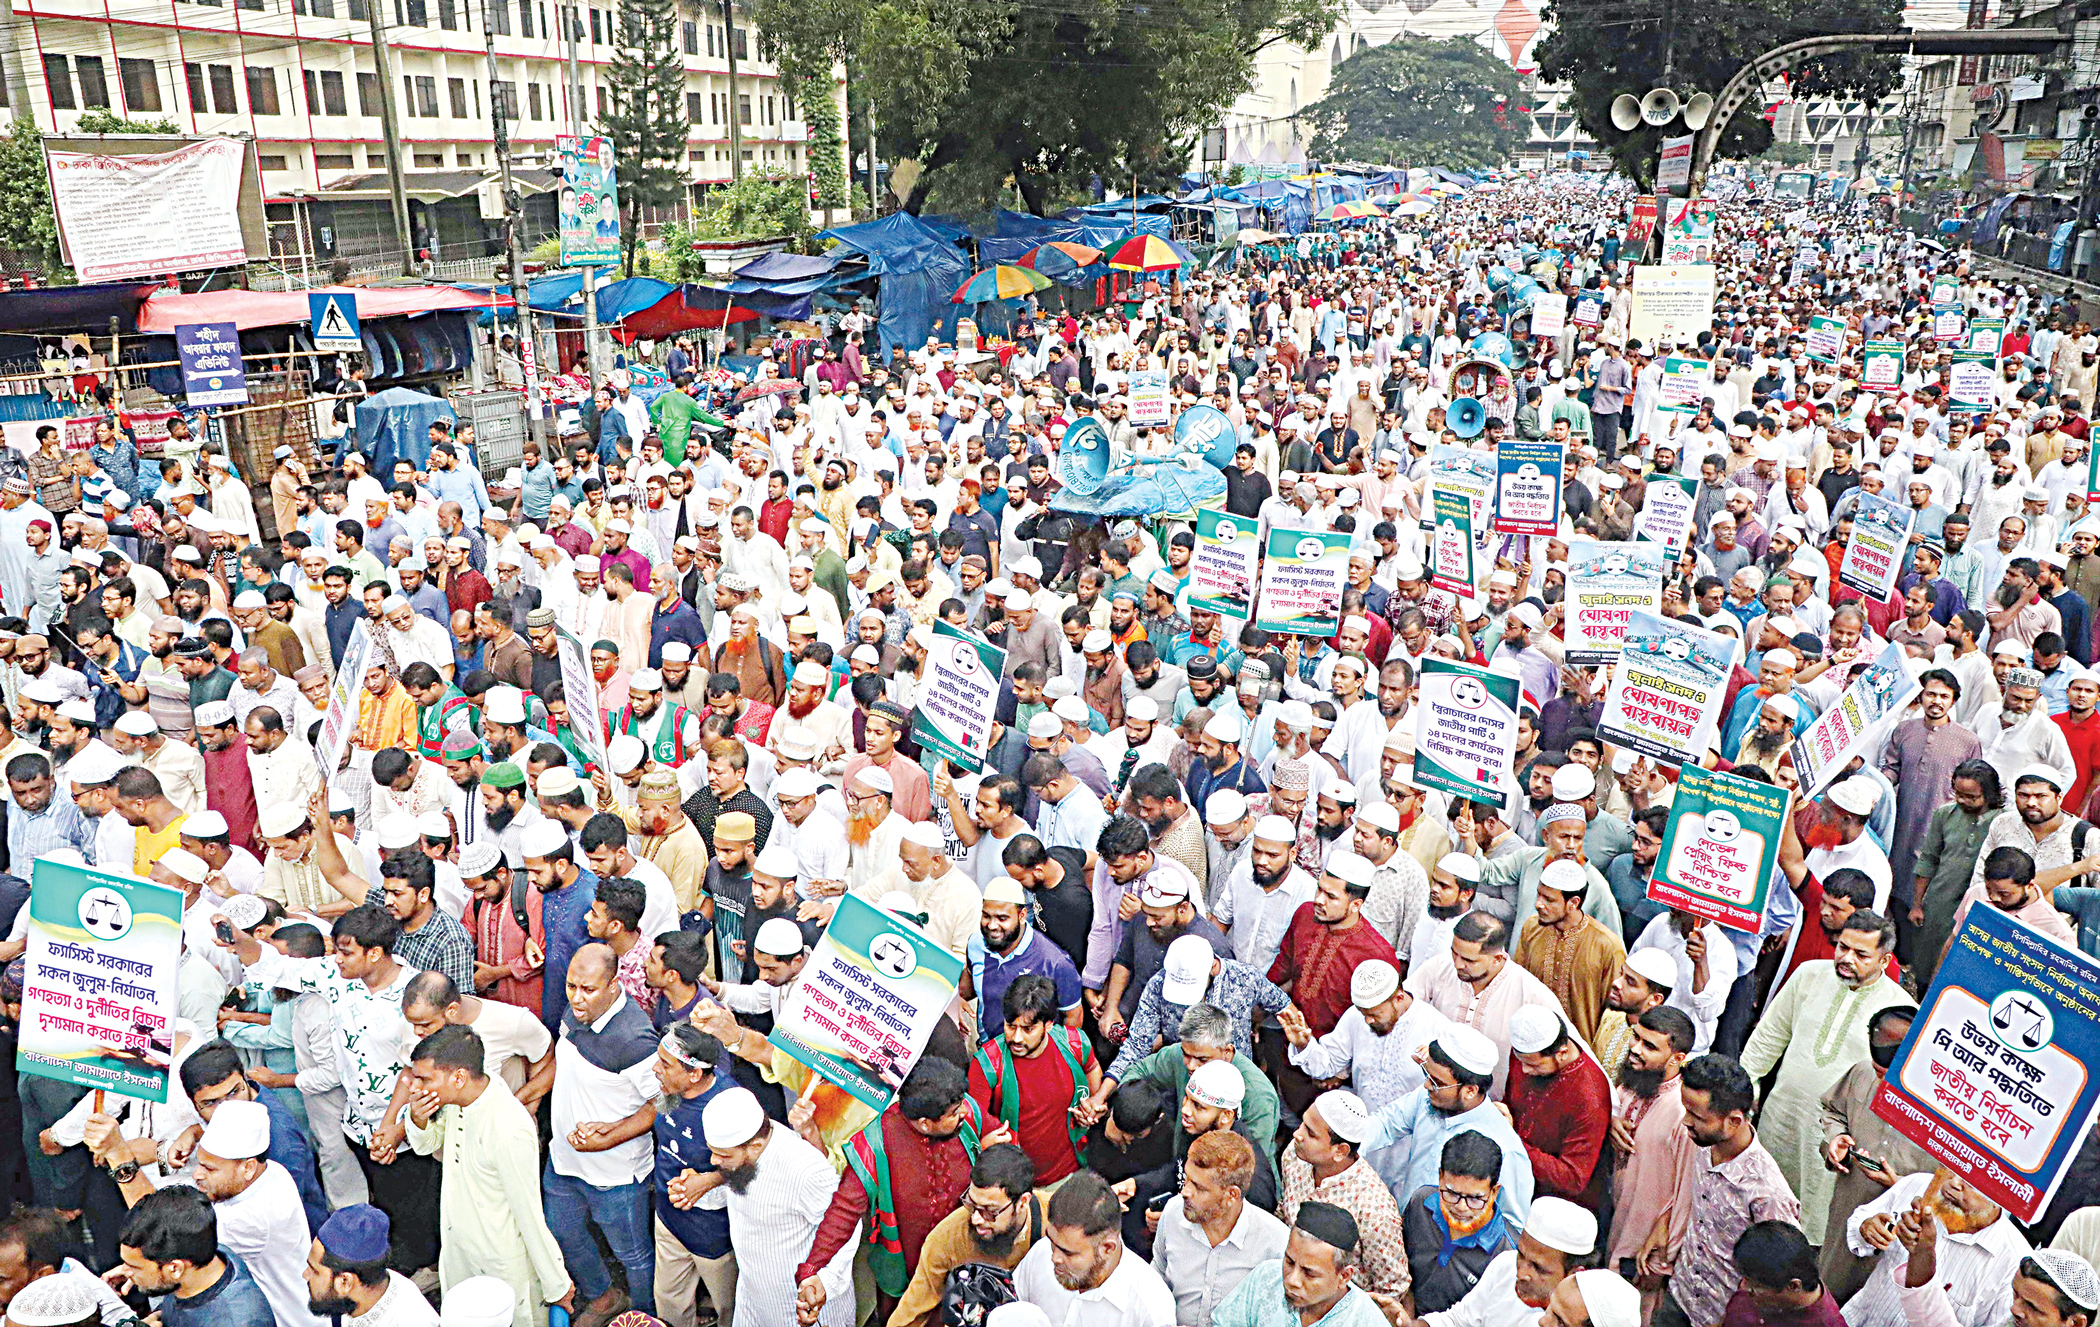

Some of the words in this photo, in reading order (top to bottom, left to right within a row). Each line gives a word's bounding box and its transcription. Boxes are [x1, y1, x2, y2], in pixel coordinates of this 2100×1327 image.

[182, 343, 211, 356] আবরার
[211, 341, 236, 353] ফাহাদ
[195, 327, 220, 341] শহীদ
[195, 355, 230, 369] এভিনিউ
[521, 342, 535, 376] UCC
[1851, 556, 1886, 579] বাস্তবায়ন
[1852, 544, 1892, 568] ঘোষণাপত্র
[1579, 609, 1633, 624] ঘোষণা
[1580, 593, 1615, 605] জুলাই
[1615, 594, 1641, 605] সনদ
[1643, 596, 1652, 606] ও
[935, 662, 969, 688] স্বৈরাচারের
[969, 680, 989, 698] দোসর
[937, 679, 959, 697] জাতীয়
[961, 690, 977, 705] পার্টি
[1627, 669, 1663, 691] জুলাই
[1664, 680, 1695, 699] সনদ
[1695, 692, 1706, 703] ও
[926, 698, 946, 718] নিষিদ্ধ
[948, 711, 968, 727] করতে
[928, 688, 939, 700] ১৪
[939, 695, 957, 710] দলের
[959, 702, 986, 724] কার্যক্রম
[1432, 701, 1477, 723] স্বৈরাচারের
[1478, 715, 1505, 730] দোসর
[1621, 701, 1695, 739] বাস্তবায়ন
[1622, 685, 1702, 724] ঘোষণাপত্র
[1428, 729, 1440, 739] ১৪
[1442, 732, 1466, 745] দলের
[1468, 740, 1504, 756] কার্যক্রম
[1438, 718, 1466, 733] জাতীয়
[1468, 727, 1487, 739] পার্টি
[1488, 732, 1496, 740] ও
[1427, 739, 1454, 756] নিষিদ্ধ
[1455, 748, 1481, 763] করতে
[1483, 757, 1502, 769] হবে।
[1684, 845, 1712, 865] প্লেয়িং
[1718, 855, 1748, 872] ফিল্ড
[1698, 837, 1738, 857] লেভেল
[1679, 869, 1713, 889] করতে
[1717, 882, 1742, 900] হবে
[1692, 860, 1732, 882] নিশ্চিত
[1728, 906, 1758, 923] ইসলামী
[48, 942, 94, 964] ফ্যাসিস্ট
[97, 953, 153, 978] সরকারের
[1968, 922, 1990, 945] আসন্ন
[1991, 935, 2019, 959] জাতীয়
[2020, 953, 2046, 972] সংসদ
[2046, 967, 2078, 990] নির্বাচন
[2012, 930, 2048, 956] বিসমিল্লাহির
[2049, 952, 2079, 973] রহমানির
[2080, 969, 2098, 983] রহিম
[38, 964, 70, 983] সকল
[73, 974, 159, 1006] জুলুম-নির্যাতন,
[832, 957, 872, 989] ফ্যাসিস্ট
[870, 982, 918, 1018] সরকারের
[1958, 934, 1993, 961] নিরপেক্ষ
[1994, 955, 2002, 966] ও
[2004, 961, 2055, 995] শান্তিপূর্ণভাবে
[2055, 991, 2097, 1020] অনুষ্ঠানের
[28, 986, 71, 1008] গণহত্যা
[74, 999, 83, 1011] ও
[86, 998, 130, 1021] দুর্নীতির
[132, 1006, 166, 1029] বিচার
[803, 982, 838, 1013] গণহত্যা
[837, 1008, 846, 1017] ও
[846, 1012, 883, 1042] দুর্নীতির
[883, 1031, 912, 1060] বিচার
[817, 969, 844, 994] সকল
[844, 988, 912, 1041] জুলুম-নির্যাতন,
[39, 1013, 84, 1034] দৃশ্যমান
[87, 1023, 122, 1043] করতে
[125, 1032, 151, 1049] হবে।
[803, 1005, 840, 1037] দৃশ্যমান
[840, 1029, 871, 1054] করতে
[868, 1050, 891, 1069] হবে।
[1960, 1020, 1999, 1055] উভয়
[24, 1050, 73, 1070] বাংলাদেশ
[75, 1061, 121, 1081] জামায়াতে
[123, 1070, 162, 1091] ইসলামী
[1932, 1028, 1952, 1054] পি
[1951, 1047, 1987, 1075] আর
[1988, 1064, 2055, 1118] পদ্ধতিতে
[855, 1076, 888, 1103] ইসলামী
[1929, 1058, 1976, 1101] জাতীয়
[1978, 1088, 2035, 1141] নির্বাচন
[1933, 1082, 1979, 1122] করতে
[1980, 1114, 2014, 1149] হবে
[1883, 1089, 1936, 1133] বাংলাদেশ
[1934, 1125, 1988, 1169] জামায়াতে
[1986, 1161, 2035, 1204] ইসলামী
[1926, 1137, 1943, 1153] ঢাকা
[1941, 1147, 1973, 1174] মহানগরী
